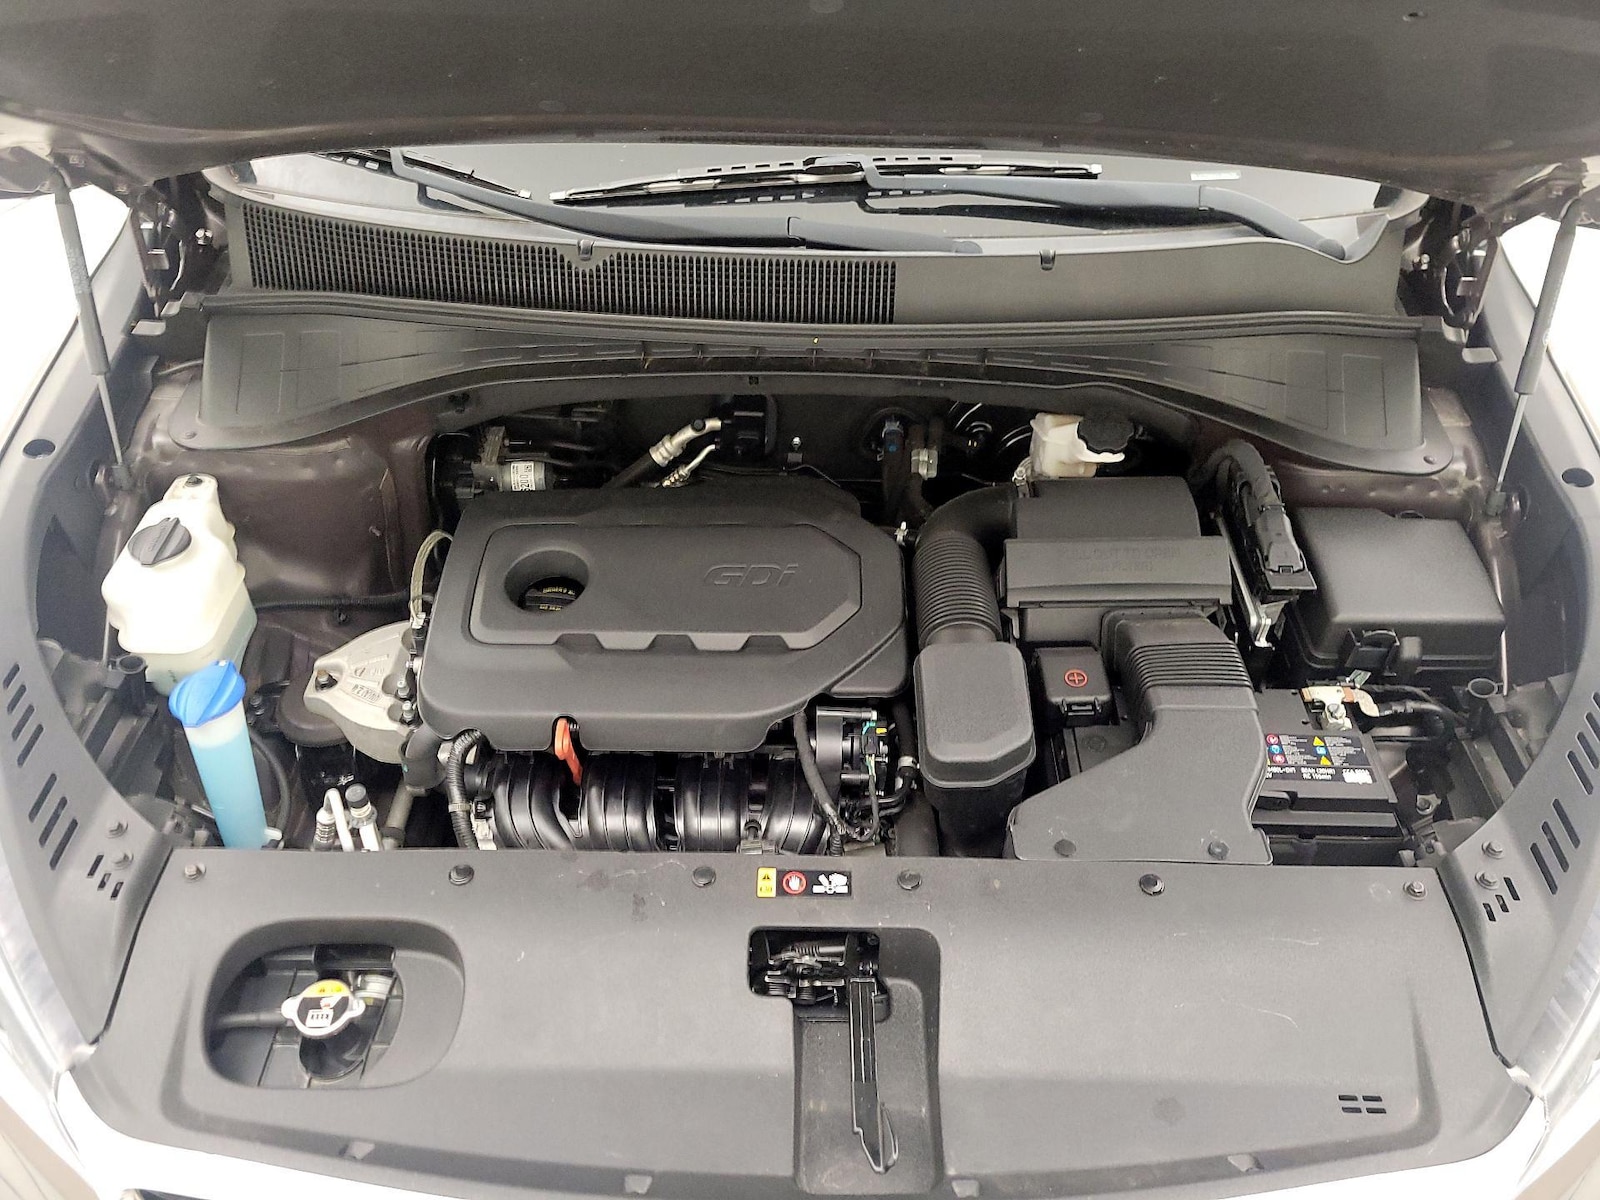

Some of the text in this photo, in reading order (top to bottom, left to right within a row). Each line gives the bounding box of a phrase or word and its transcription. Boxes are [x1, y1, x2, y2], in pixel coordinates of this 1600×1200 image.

[1093, 547, 1120, 560] OUT
[1123, 547, 1141, 560] TO
[1144, 546, 1181, 559] OPEN
[703, 562, 799, 586] GDi
